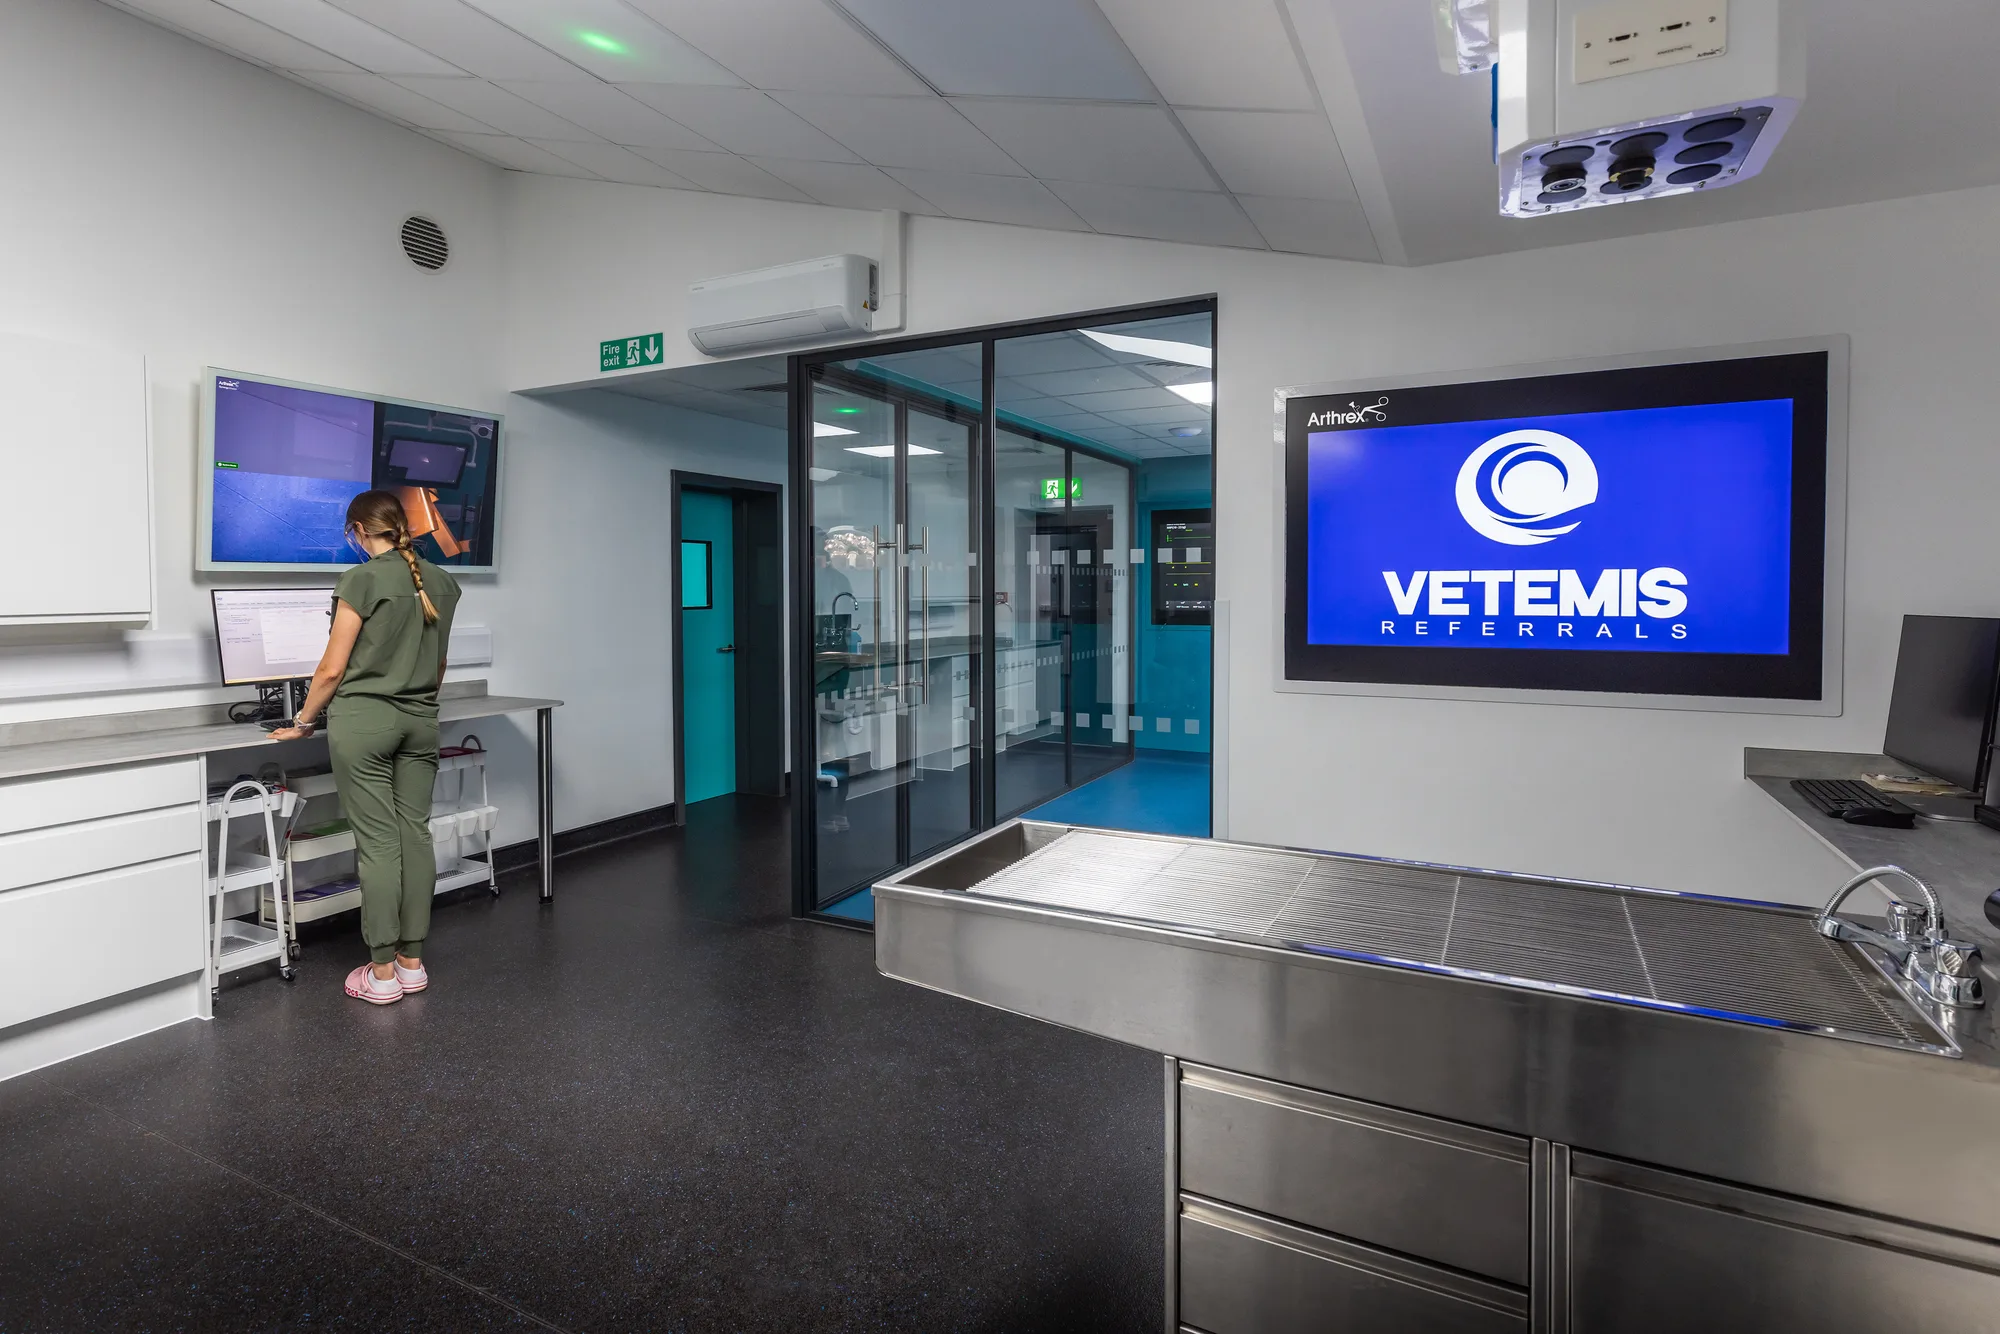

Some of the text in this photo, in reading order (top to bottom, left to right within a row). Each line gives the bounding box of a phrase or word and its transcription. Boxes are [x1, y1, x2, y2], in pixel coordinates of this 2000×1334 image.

[603, 344, 620, 355] Fire
[603, 355, 620, 366] exit
[1307, 406, 1368, 427] Arthrex
[1382, 567, 1688, 619] VETEMIS
[1381, 620, 1687, 639] REFERRALS
